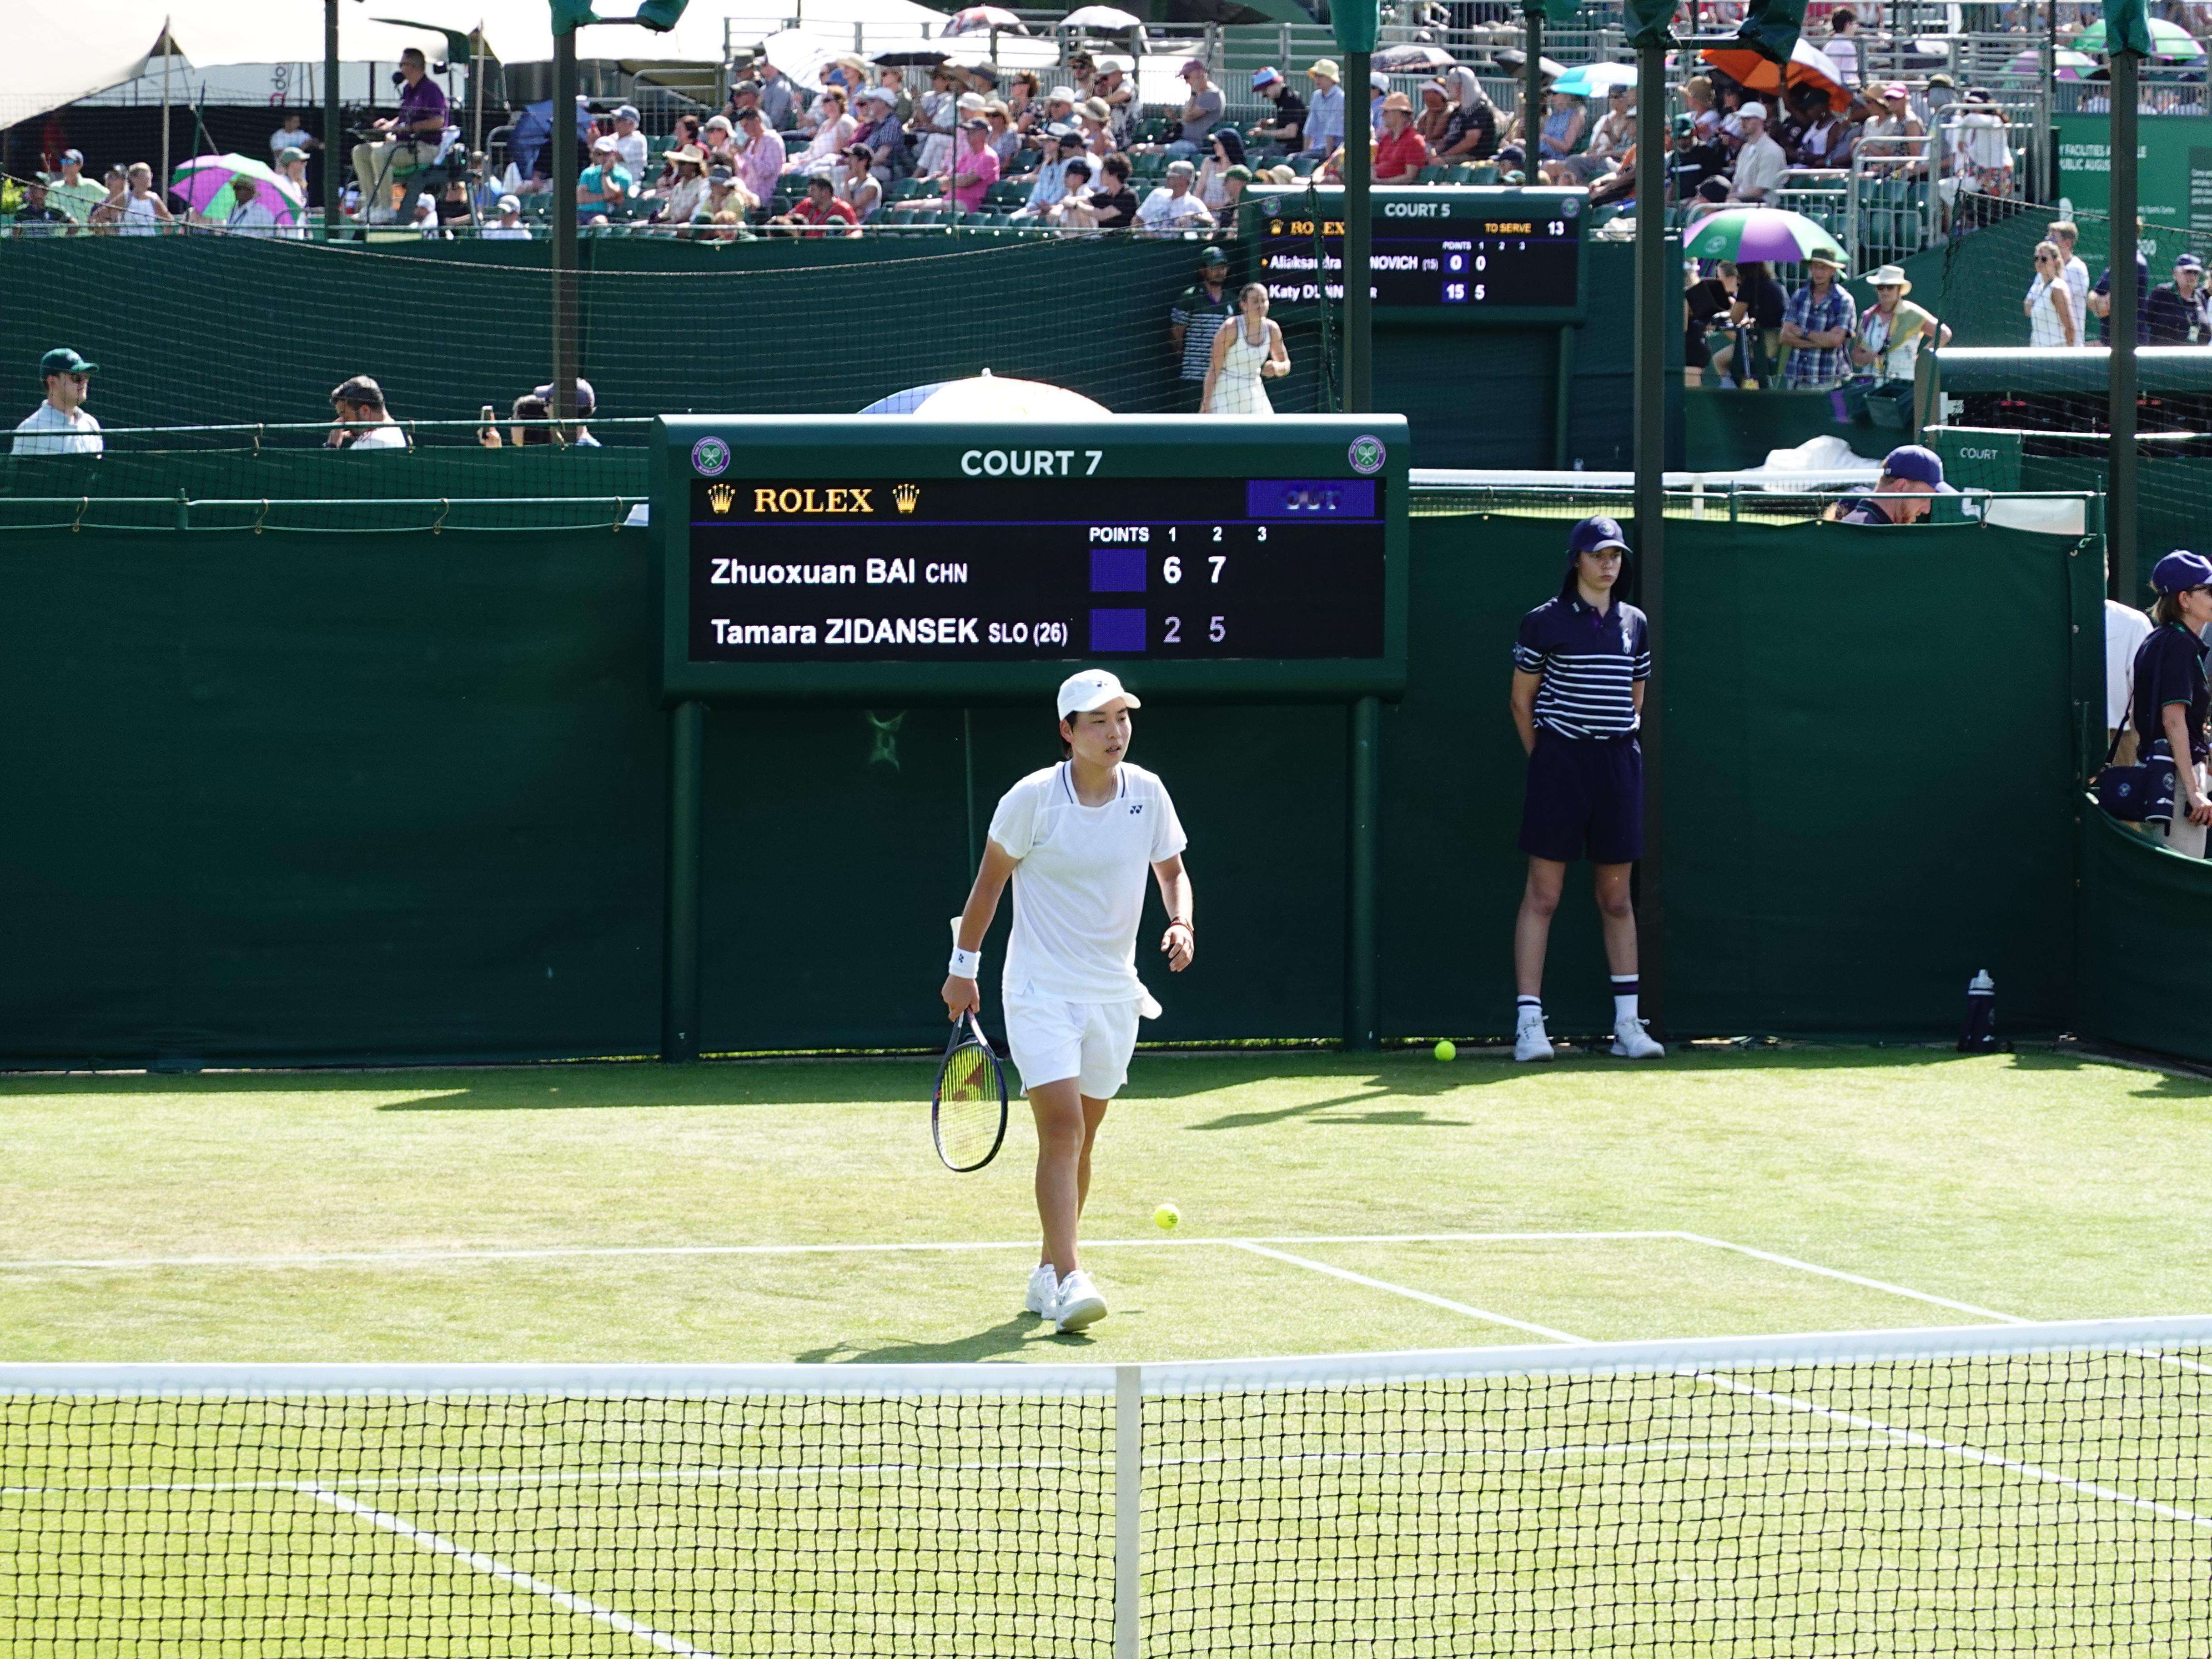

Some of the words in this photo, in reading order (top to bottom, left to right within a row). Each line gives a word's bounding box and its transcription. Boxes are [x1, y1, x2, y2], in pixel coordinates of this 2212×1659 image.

[1384, 203, 1438, 217] COURT
[1440, 203, 1451, 217] 5
[1290, 221, 1345, 235] ROEX
[1484, 223, 1498, 233] TO
[1499, 223, 1532, 233] SERVE
[1547, 221, 1564, 236] 13
[1442, 241, 1472, 250] POINTS
[1478, 241, 1484, 250] 1
[1498, 241, 1505, 250] 2
[1518, 241, 1525, 250] 3
[1369, 255, 1418, 270] NOVICH
[1450, 255, 1462, 271] 0
[1475, 255, 1486, 271] 0
[1269, 284, 1301, 302] Katy
[1446, 284, 1465, 300] 15
[1474, 284, 1485, 300] 5
[1960, 447, 1999, 460] COURT
[960, 449, 1075, 476] COURT
[1085, 450, 1103, 475] 7
[754, 488, 874, 513] ROLEX
[1089, 527, 1150, 542] POINTS
[1168, 526, 1176, 542] 1
[1212, 526, 1222, 542] 2
[1257, 526, 1267, 542] 3
[710, 558, 856, 584] Zhuoxuan
[866, 558, 915, 584] BAI
[925, 563, 968, 583] CHN
[1163, 555, 1182, 584] 6
[1207, 555, 1227, 584] 7
[710, 618, 817, 645] Tamara
[824, 618, 980, 644] ZIDANSEK
[988, 622, 1028, 643] SLO
[1033, 622, 1068, 648] (26)
[1162, 616, 1181, 643] 2
[1208, 615, 1227, 643] 5
